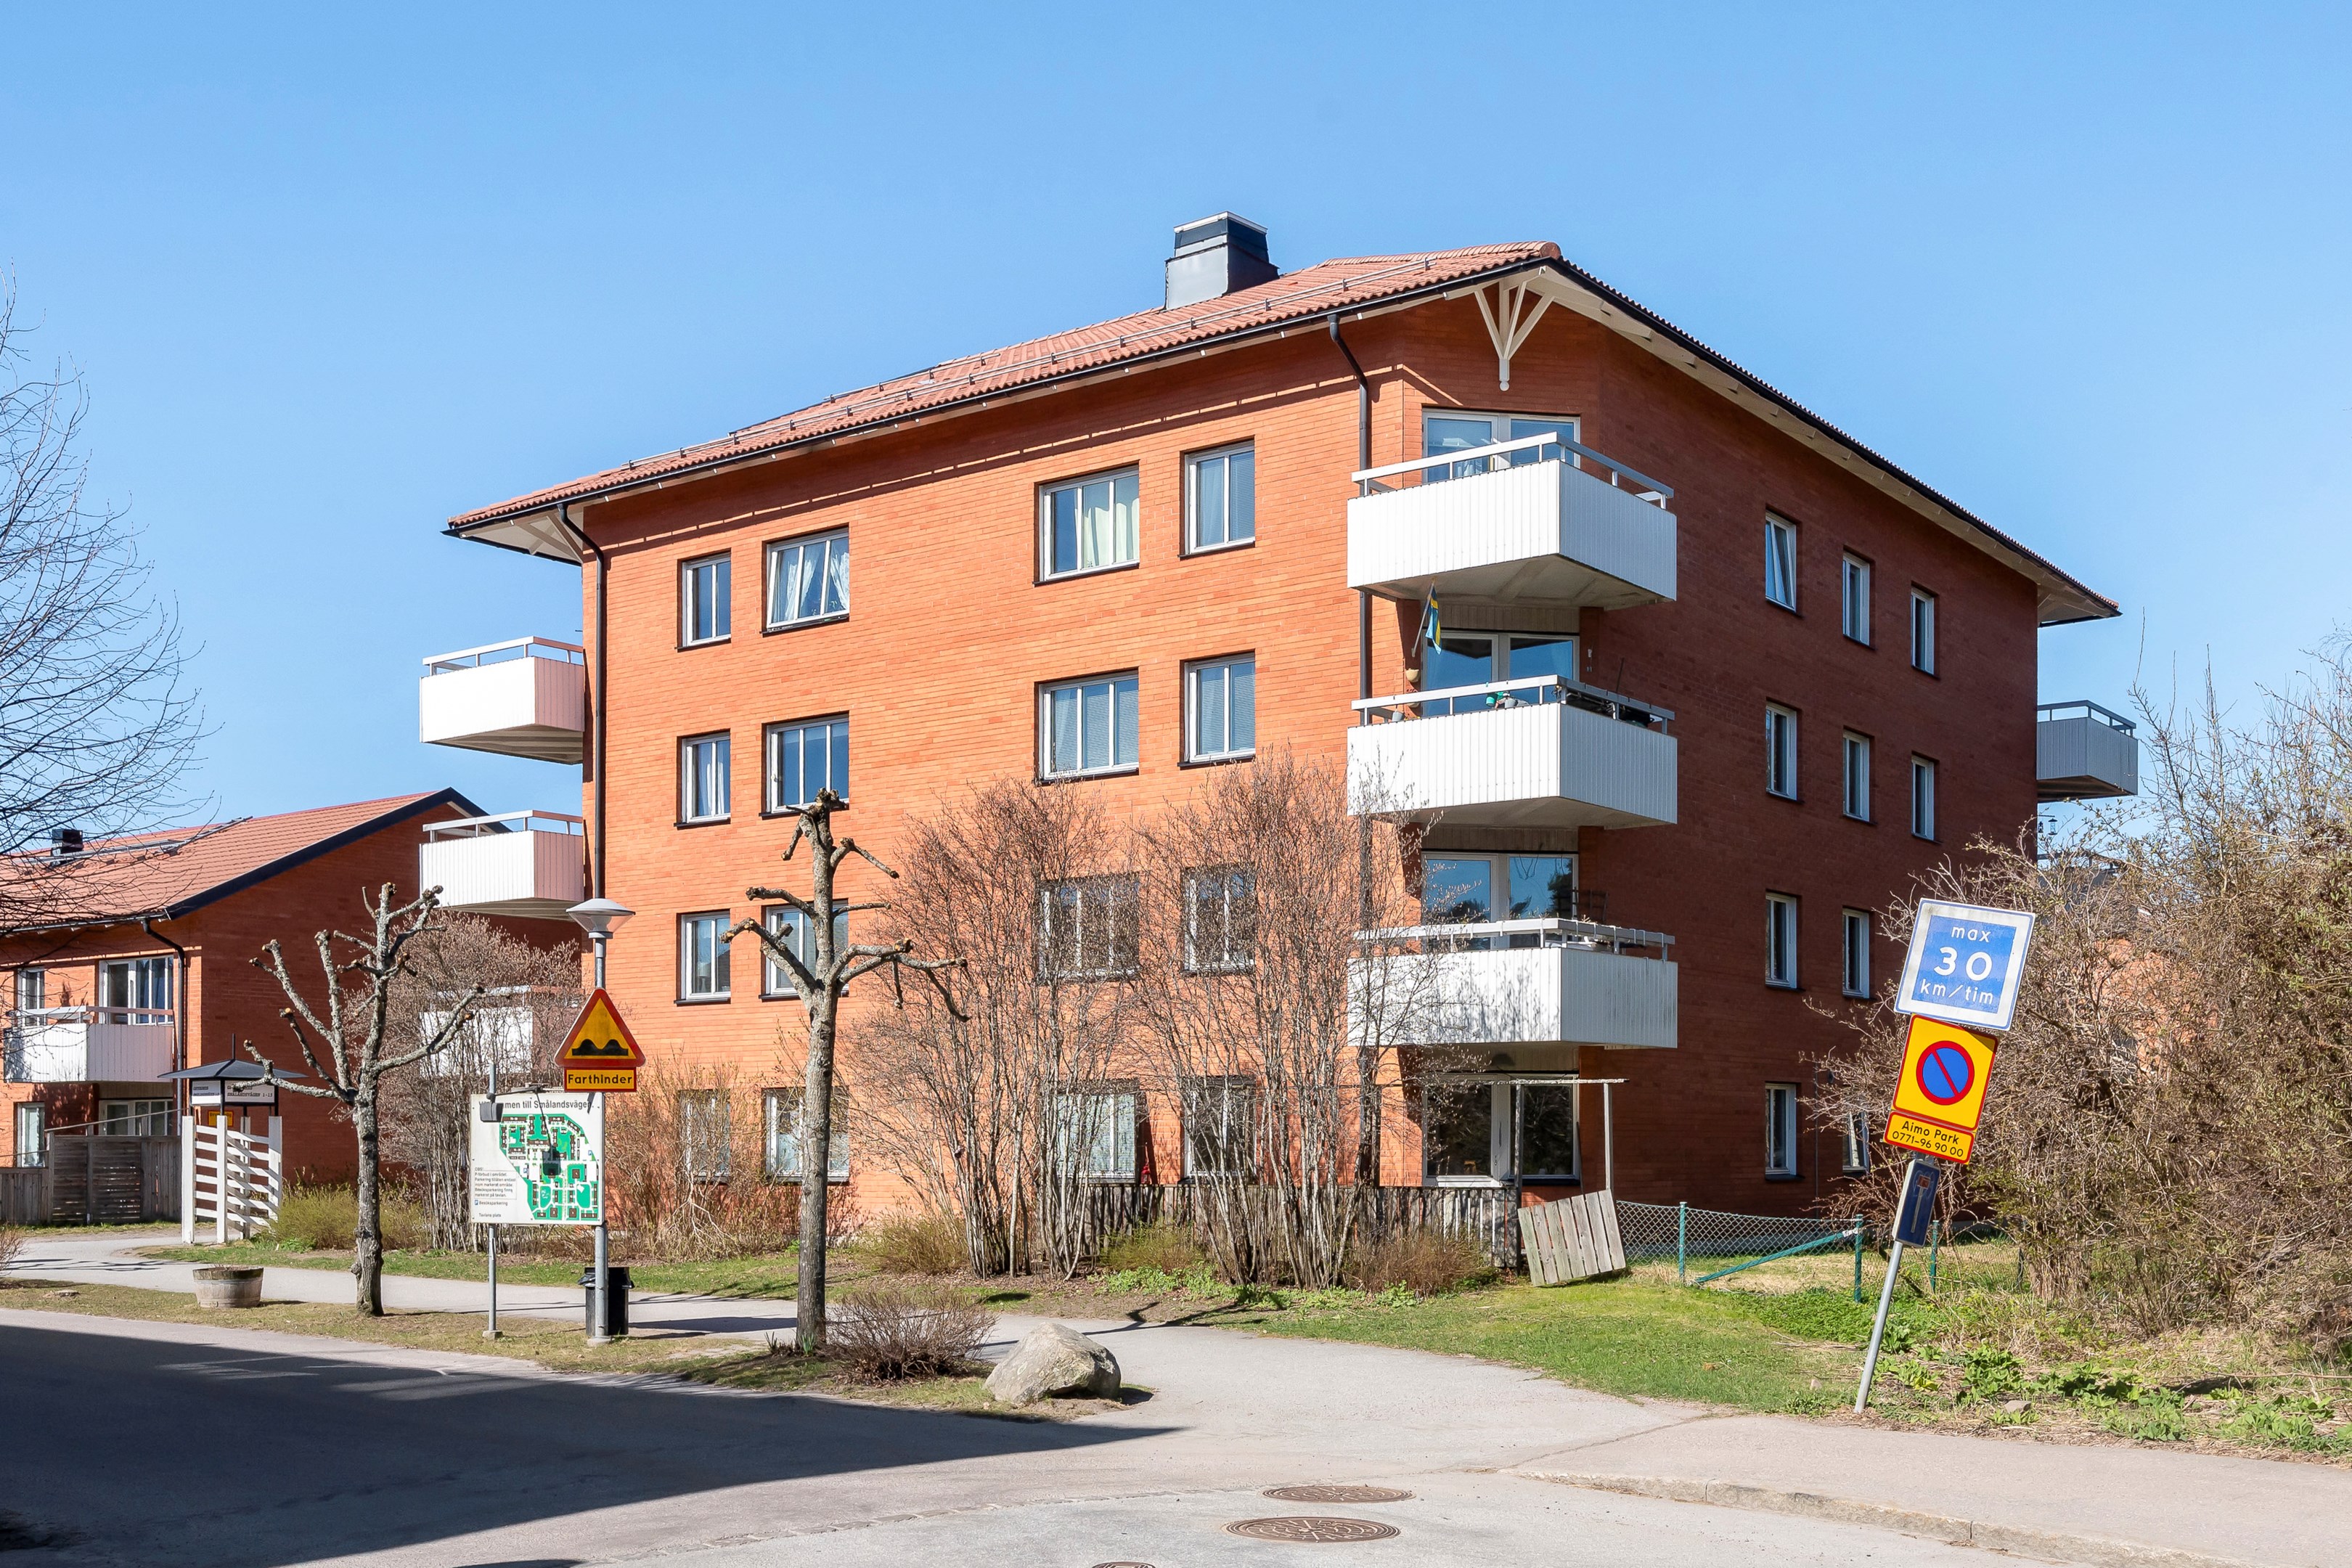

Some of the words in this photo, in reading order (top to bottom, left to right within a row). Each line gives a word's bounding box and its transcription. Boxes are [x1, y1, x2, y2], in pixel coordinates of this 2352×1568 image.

[1951, 926, 1991, 943] max
[1933, 947, 1993, 981] 30
[1920, 979, 1994, 1005] km/tim
[568, 1074, 633, 1084] Farthinder
[1892, 1131, 1932, 1148] 0771-96
[1935, 1143, 1948, 1153] 90
[1949, 1147, 1964, 1157] 00
[1901, 1120, 1930, 1137] Aimo
[1934, 1129, 1959, 1145] Park
